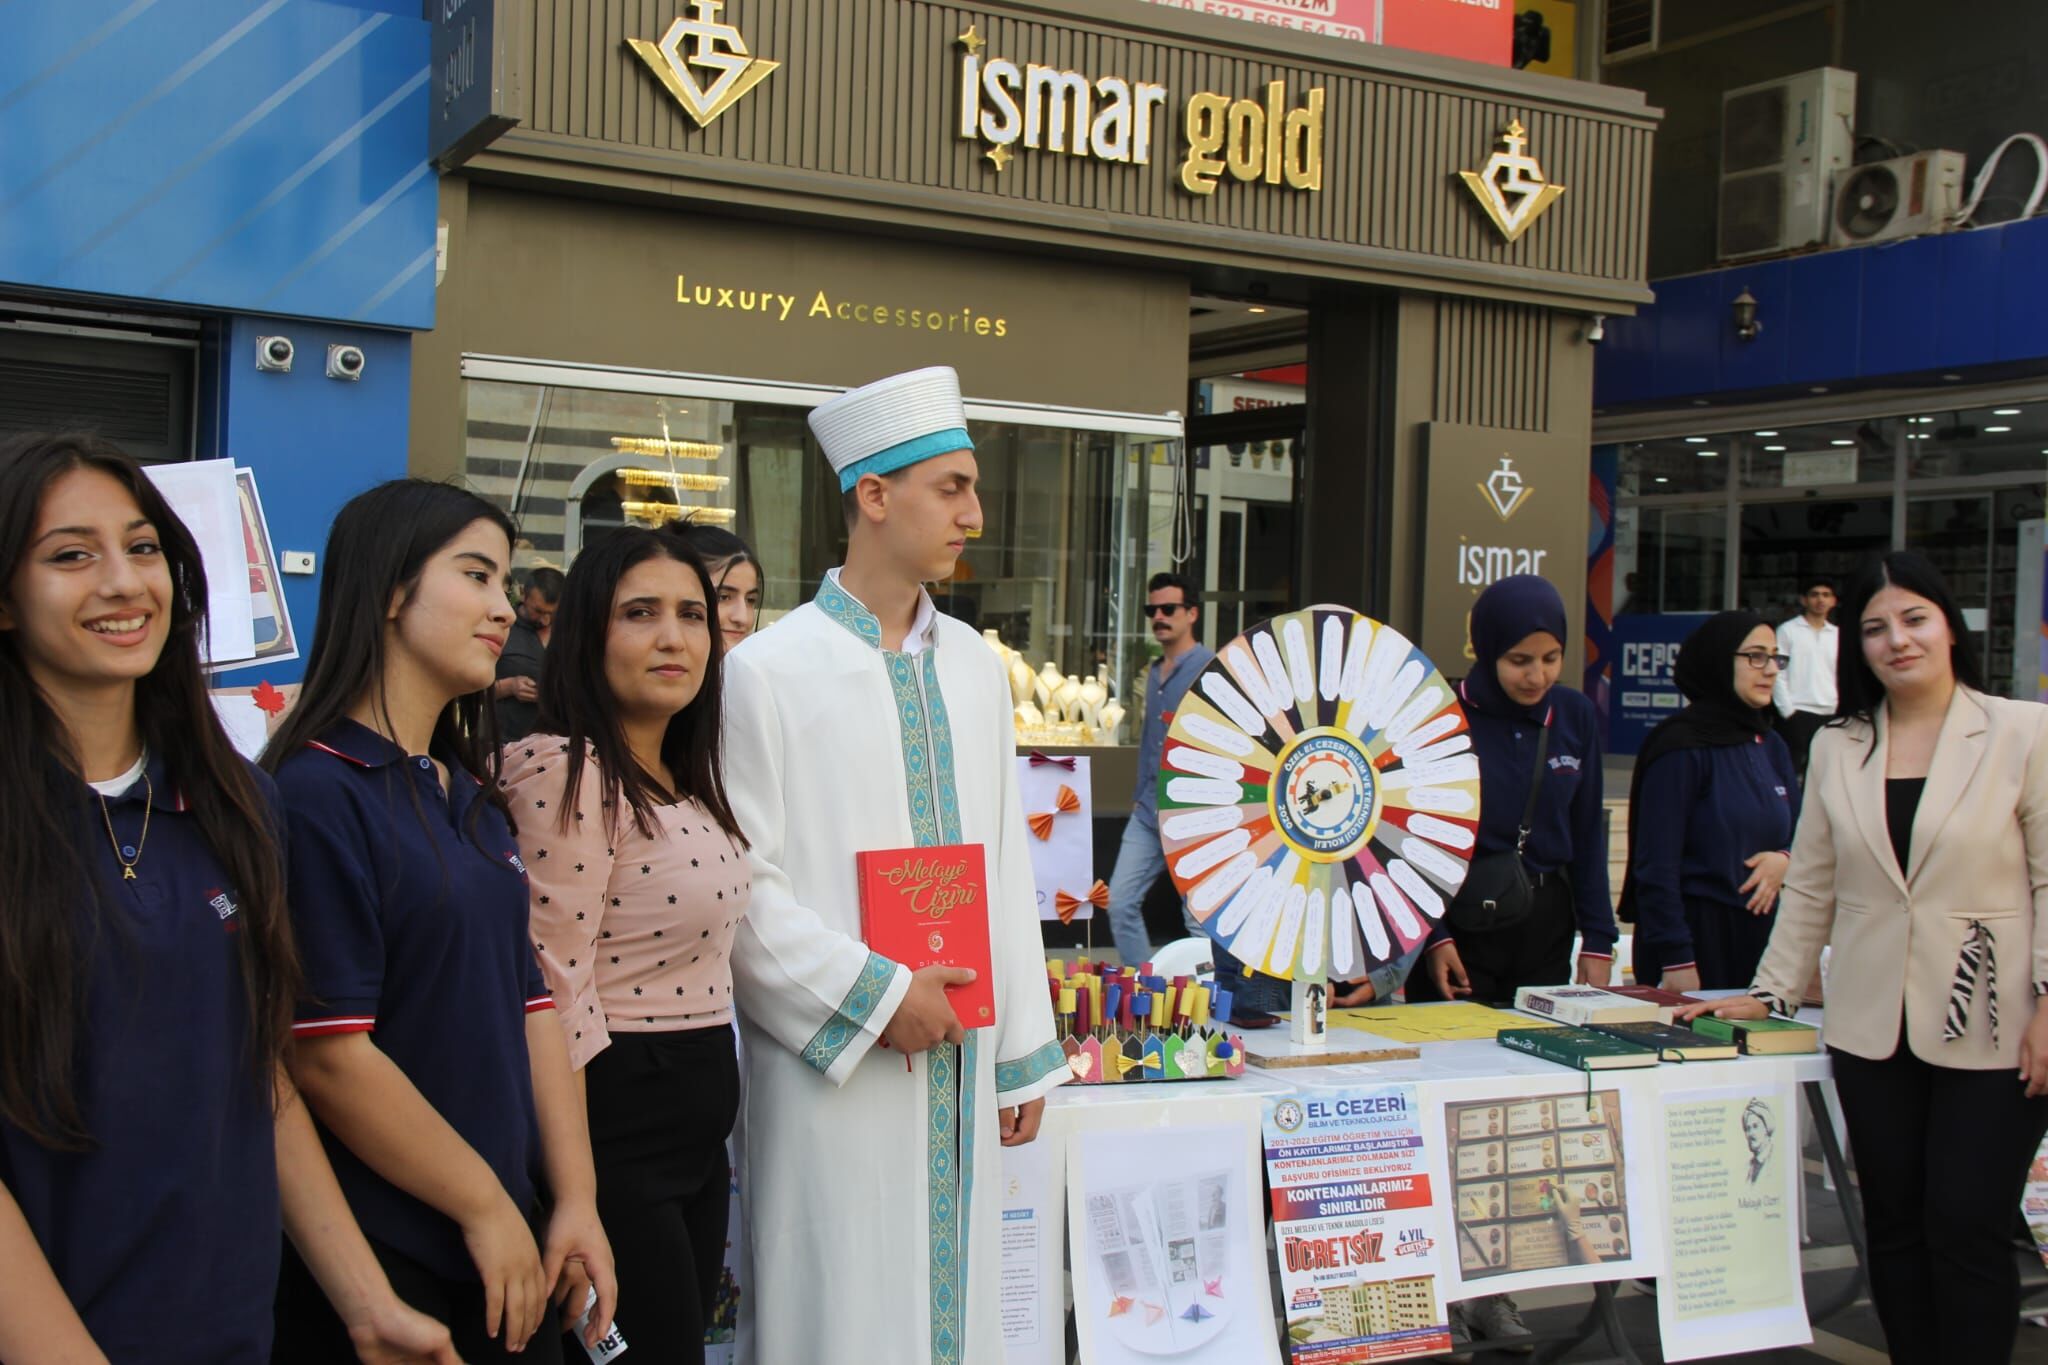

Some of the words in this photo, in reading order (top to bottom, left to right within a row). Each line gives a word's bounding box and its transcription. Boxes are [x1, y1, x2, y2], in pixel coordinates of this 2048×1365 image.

[1180, 81, 1326, 195] gold
[676, 274, 795, 321] Luxury
[809, 290, 1008, 337] Accessories
[1284, 749, 1305, 772] ÖZEL
[1304, 743, 1314, 753] EL
[1315, 740, 1348, 753] CEZERİ
[1348, 750, 1368, 774] BİLİM
[1362, 774, 1372, 791] VE
[1278, 804, 1294, 830] 2020
[1307, 1102, 1331, 1118] EL
[1336, 1093, 1407, 1116] CEZERİ
[1329, 1119, 1341, 1127] VE
[1271, 1137, 1310, 1147] 2021-2022
[1278, 1147, 1292, 1157] ÖN
[1293, 1144, 1352, 1156] KAYITLARIMIZ
[1354, 1138, 1410, 1152] BAŞLAMIŞTIR
[1274, 1156, 1355, 1169] KONTENJANLARIMIZ
[1356, 1152, 1400, 1162] DOLMADAN
[1281, 1171, 1320, 1183] BAŞVURU
[1363, 1162, 1412, 1175] BEKLİYORUZ
[1287, 1179, 1414, 1202] KONTENJANLARIMIZ
[1319, 1197, 1386, 1215] SINIRLIDIR
[1399, 1231, 1407, 1242] 4
[1408, 1228, 1425, 1241] YIL
[1284, 1228, 1386, 1272] ÜCRETSİZ
